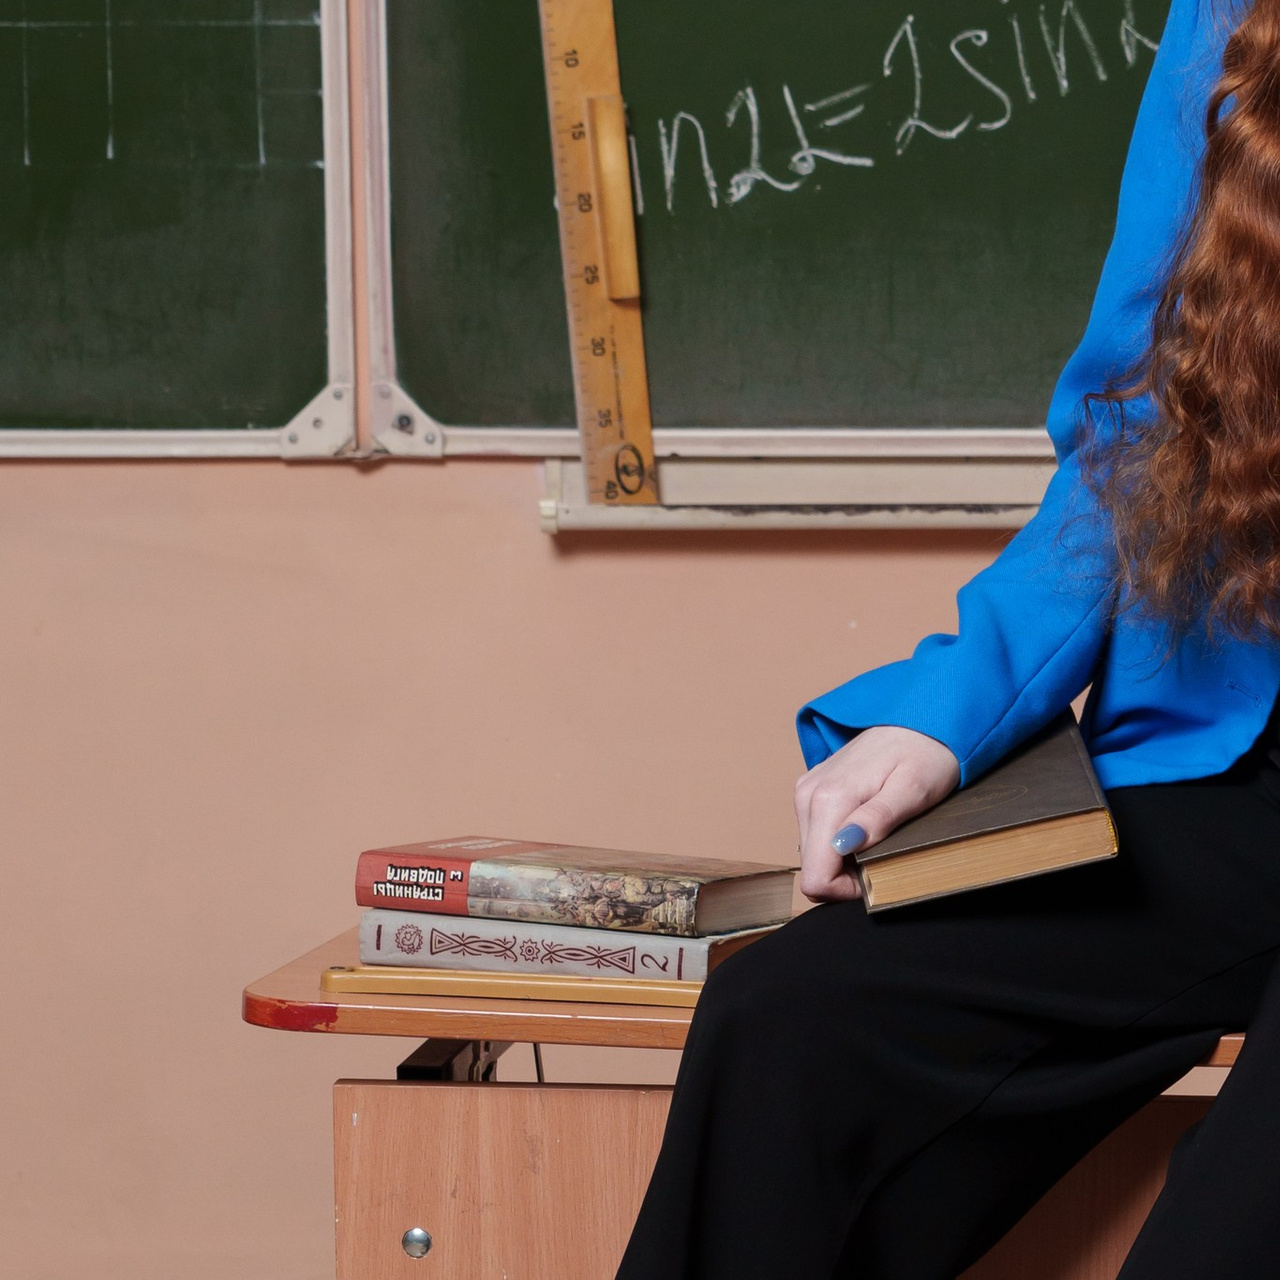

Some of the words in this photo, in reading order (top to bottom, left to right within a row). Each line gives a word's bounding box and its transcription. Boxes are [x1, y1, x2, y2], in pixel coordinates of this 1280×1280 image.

[564, 49, 580, 69] 10
[570, 122, 586, 141] 15
[577, 192, 593, 214] 20
[584, 265, 600, 285] 25
[590, 337, 606, 357] 30
[597, 409, 612, 429] 35
[386, 865, 445, 884] ПОДВИГА
[373, 881, 444, 901] СТРАНИЦЫ
